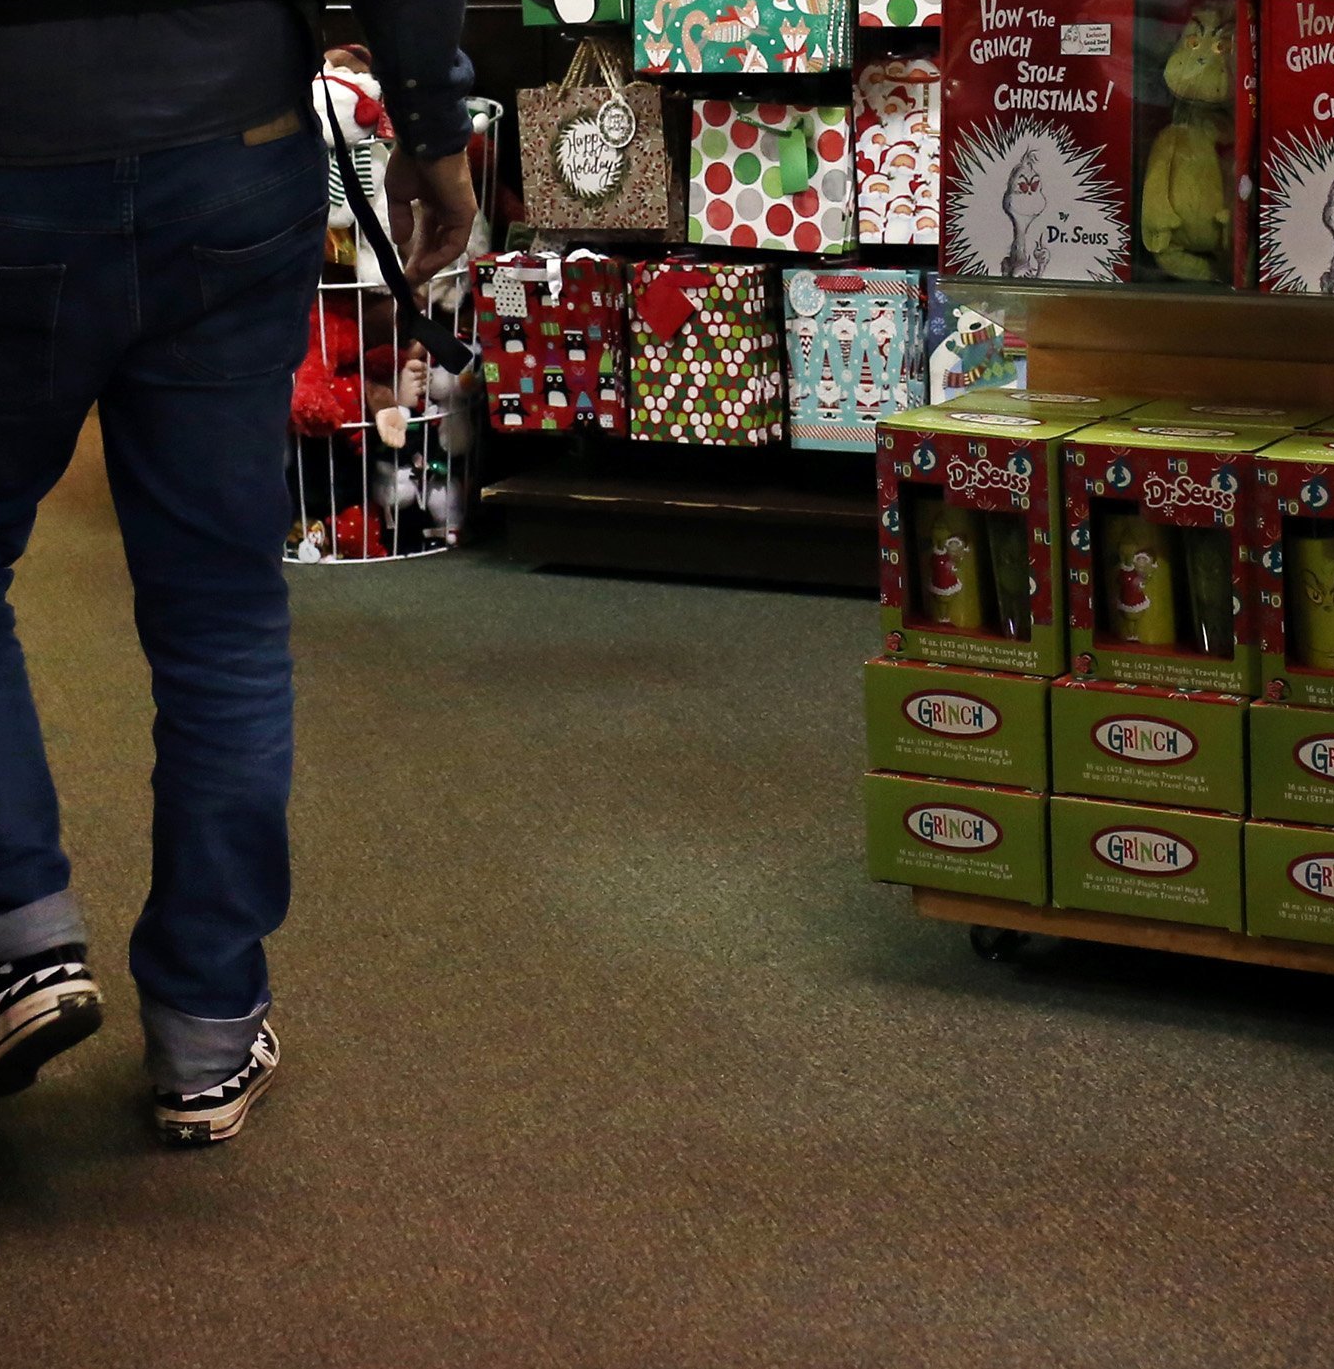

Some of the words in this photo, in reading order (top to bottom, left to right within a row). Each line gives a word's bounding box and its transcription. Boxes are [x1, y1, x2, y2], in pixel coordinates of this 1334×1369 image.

[1027, 10, 1055, 28] The
[969, 36, 1033, 64] GRINCH
[1017, 61, 1066, 83] STOLE
[567, 130, 609, 158] Happy
[1047, 226, 1068, 244] Dr.
[1071, 226, 1109, 245] Seuss
[877, 433, 894, 450] HO
[969, 442, 987, 458] HO
[1065, 450, 1085, 466] HO
[893, 462, 912, 478] HO
[1168, 458, 1188, 474] HO
[1257, 470, 1278, 486] HO
[1085, 480, 1105, 496] HO
[1011, 494, 1031, 510] HO
[1277, 499, 1299, 515] HO
[1214, 512, 1235, 526] HO
[881, 548, 899, 564] HO
[1069, 570, 1089, 585] HO
[1261, 592, 1281, 608] HO
[995, 648, 1017, 656] Travel
[992, 657, 1011, 666] Travel
[918, 698, 984, 728] GRINCH
[1107, 724, 1178, 754] GRINCH
[919, 812, 985, 842] GRINCH
[1107, 835, 1178, 866] GRINCH
